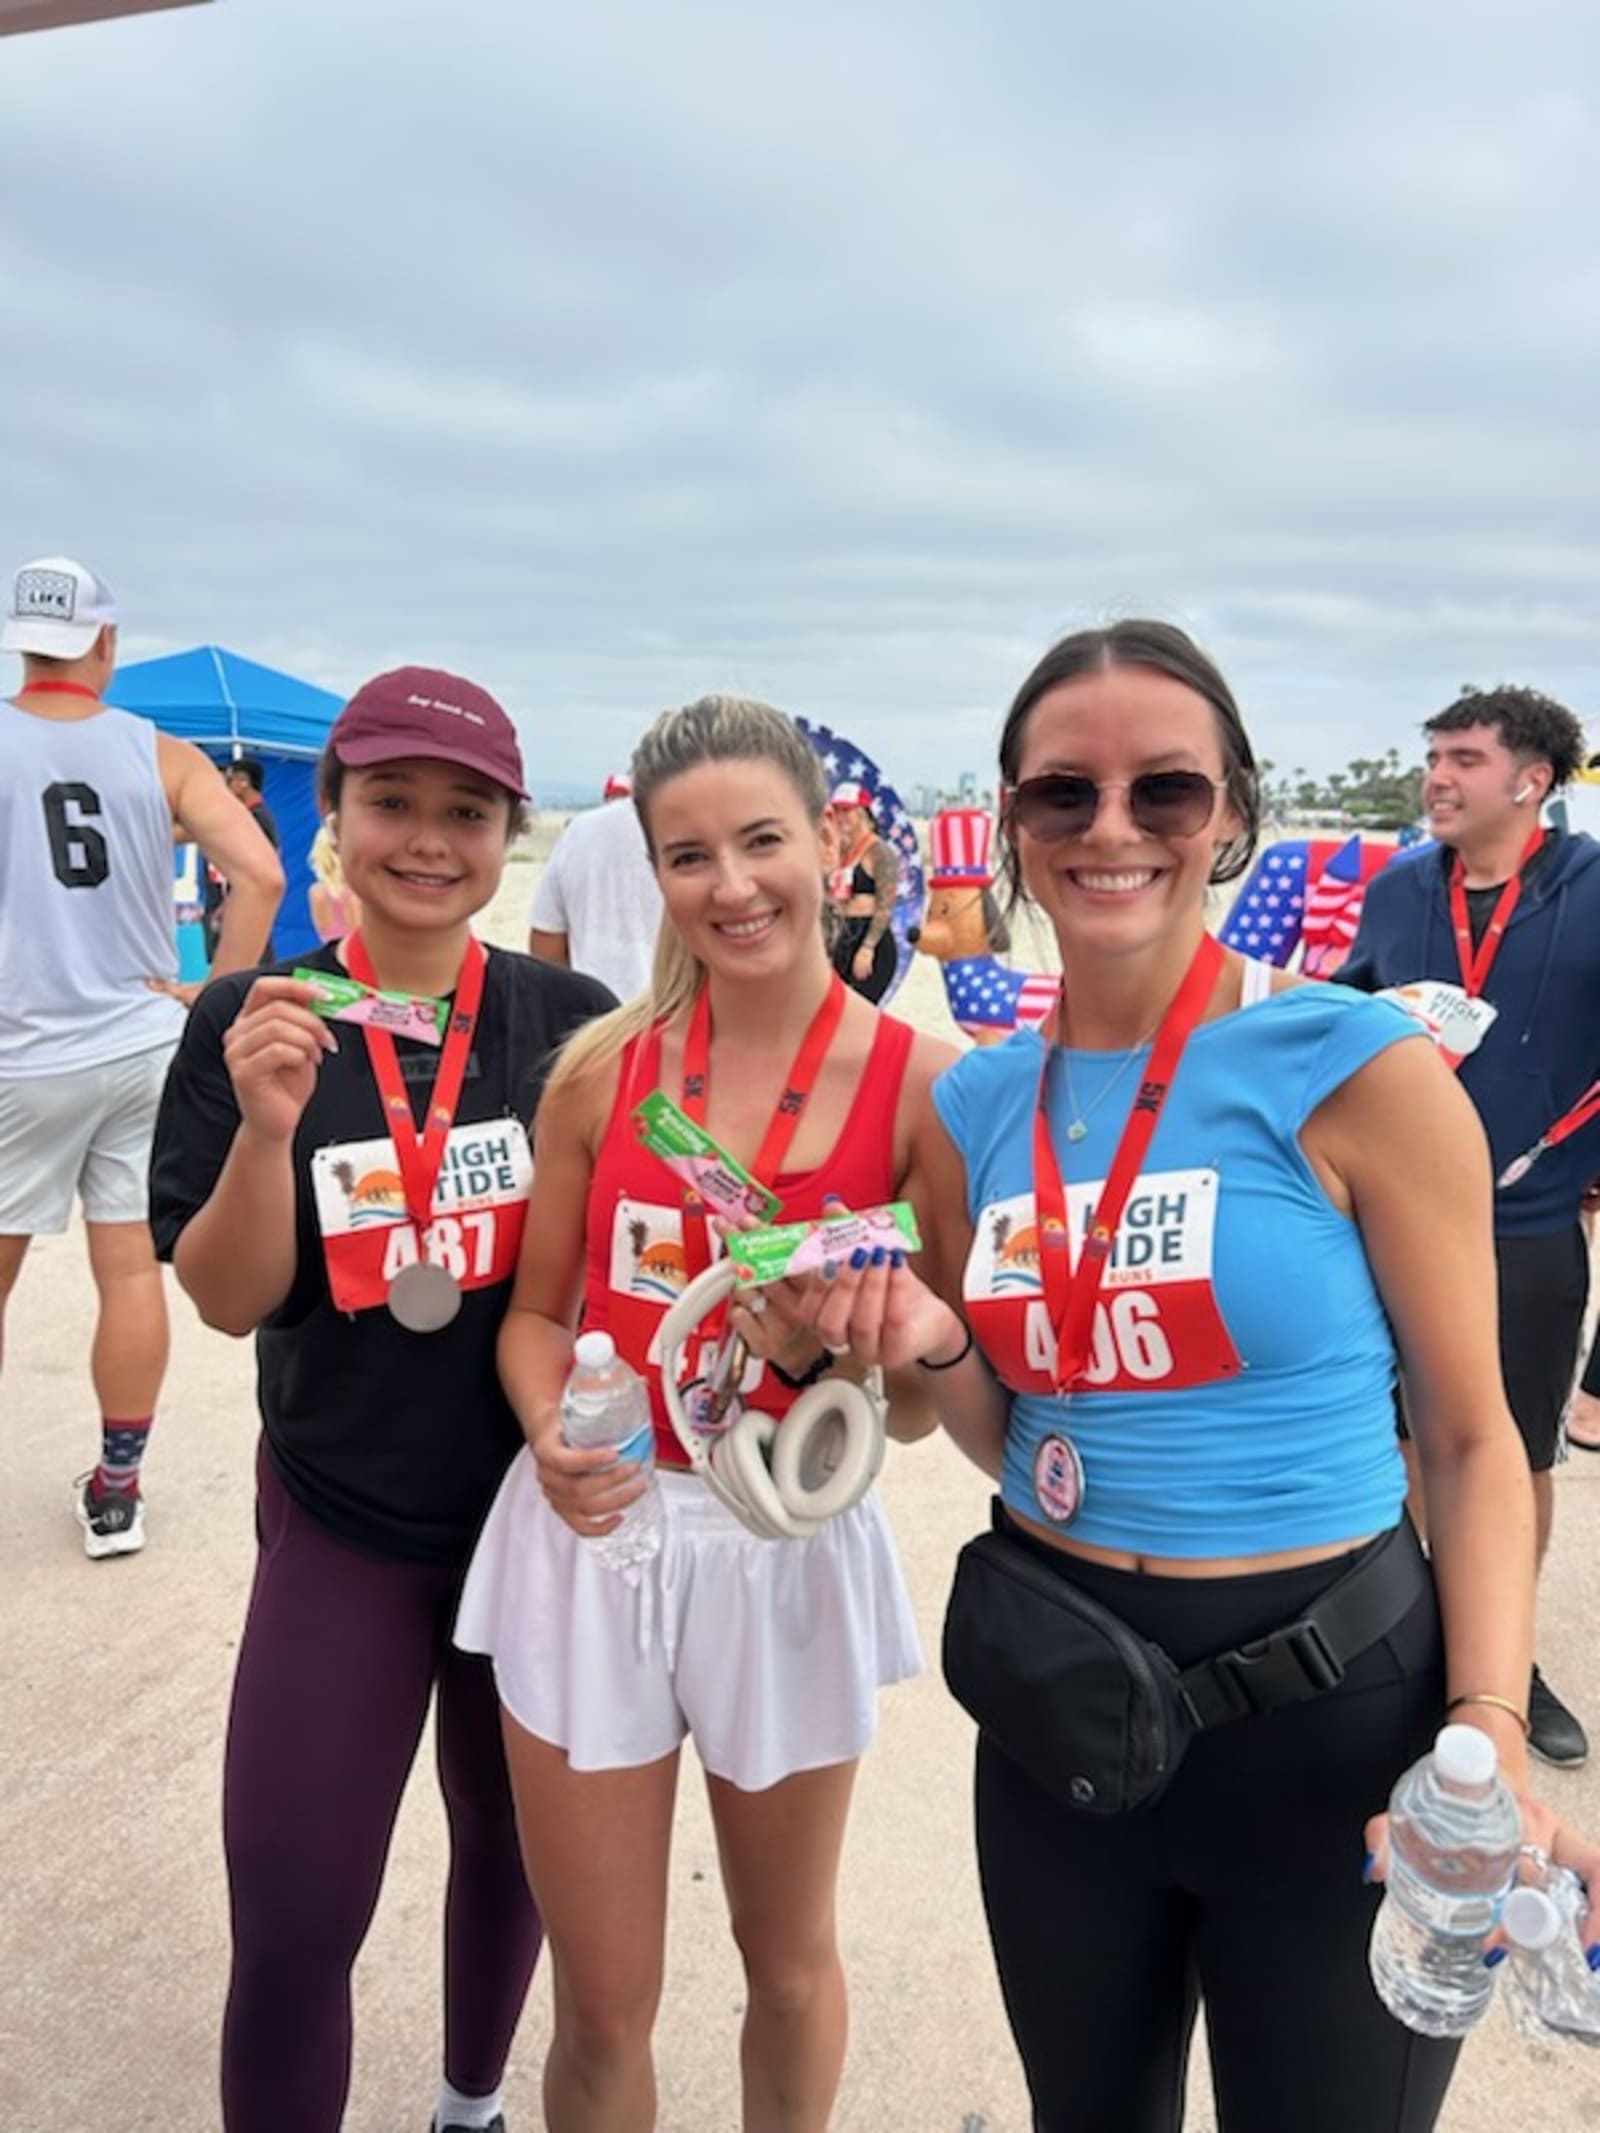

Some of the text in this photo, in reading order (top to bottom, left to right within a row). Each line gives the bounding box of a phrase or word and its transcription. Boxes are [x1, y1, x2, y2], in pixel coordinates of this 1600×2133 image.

[42, 782, 110, 888] 6
[1135, 1082, 1166, 1113] 5K
[436, 1165, 516, 1201] TIDE
[382, 1209, 497, 1282] 487
[1109, 1229, 1183, 1268] IDE
[1108, 1268, 1153, 1283] RUNS
